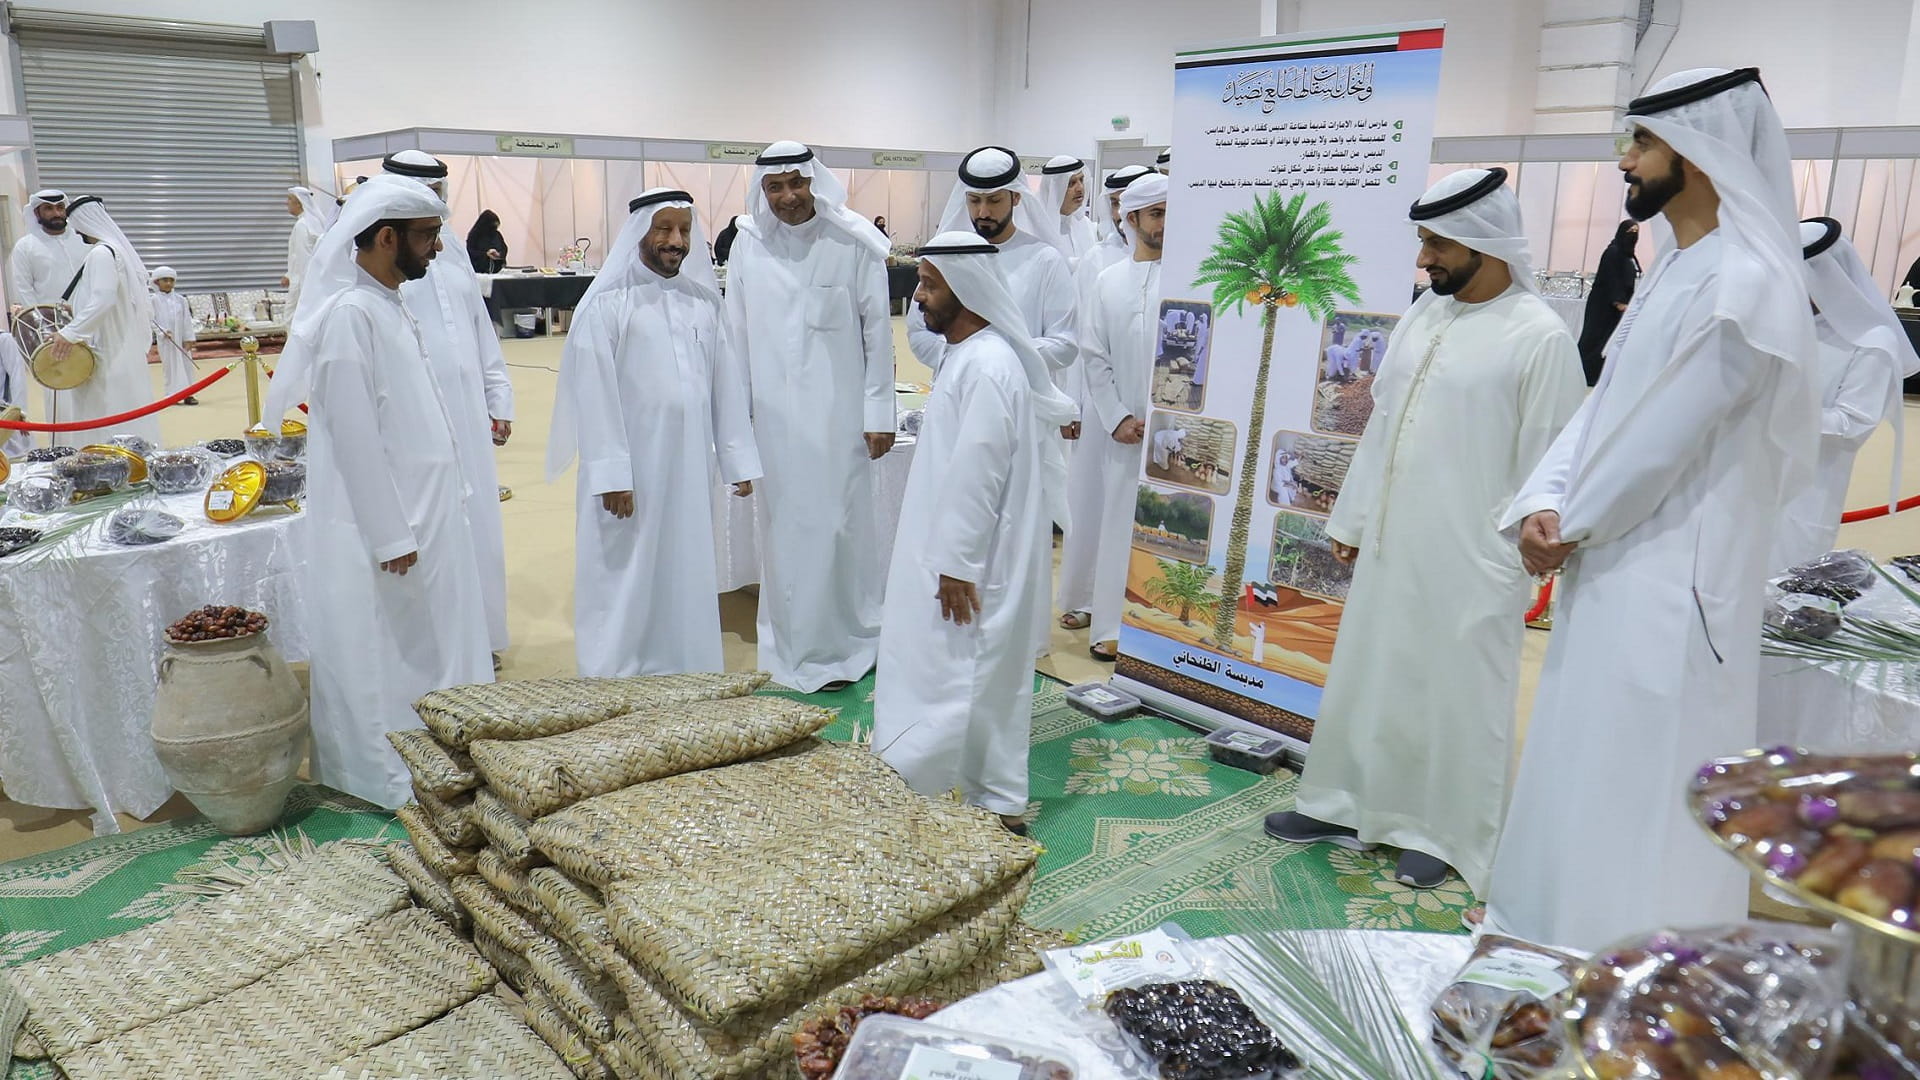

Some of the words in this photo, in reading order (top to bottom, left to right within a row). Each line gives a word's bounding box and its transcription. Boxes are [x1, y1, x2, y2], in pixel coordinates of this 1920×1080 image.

[1227, 125, 1240, 134] خلال
[1241, 126, 1249, 134] من
[1269, 123, 1288, 132] الدبس
[1289, 122, 1307, 130] صناعة
[1319, 135, 1327, 145] ولا
[1329, 136, 1344, 145] واحد
[1346, 135, 1356, 146] باب
[1322, 148, 1349, 159] الحشرات
[1350, 150, 1359, 159] من
[1363, 149, 1385, 159] الدبس
[1287, 163, 1301, 174] شكل
[1366, 163, 1382, 174] تكون
[1173, 651, 1222, 673] الظنحاني
[1225, 663, 1264, 690] مدبسة
